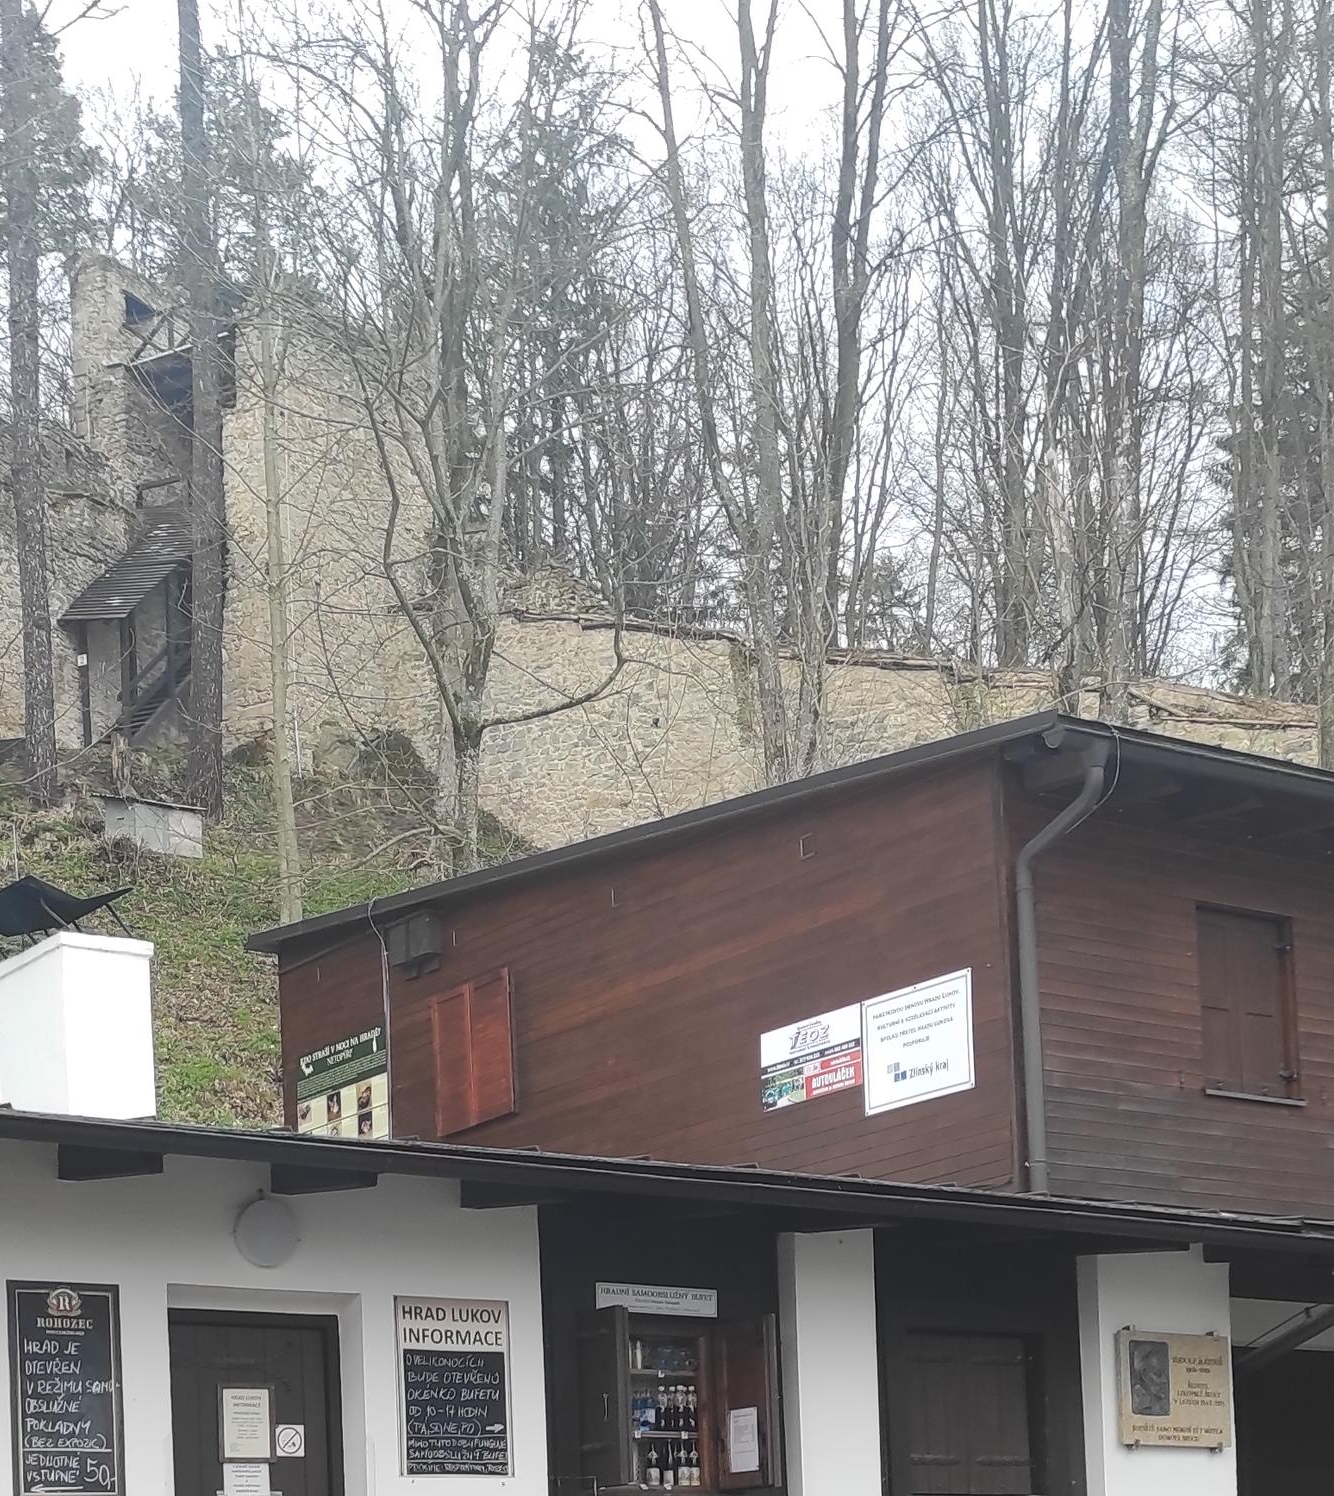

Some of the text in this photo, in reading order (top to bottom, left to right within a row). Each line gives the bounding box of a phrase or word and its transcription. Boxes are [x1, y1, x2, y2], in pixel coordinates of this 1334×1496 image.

[909, 1058, 949, 1079] Zlínský kraj
[600, 1287, 629, 1296] HRADNÍ
[402, 1305, 502, 1324] HRAD LUKOV
[36, 1317, 93, 1329] ROHOZEC
[403, 1327, 503, 1346] INFORMACE
[24, 1339, 80, 1354] HRAD JE
[26, 1357, 81, 1375] OTEVŘEN
[408, 1370, 499, 1384] BUDE OTEVŘENO
[27, 1382, 33, 1395] V
[38, 1377, 83, 1394] REŽIMU
[407, 1383, 499, 1401] OKÉNKO BUFETU
[409, 1406, 421, 1417] OD
[458, 1406, 488, 1417] HODIN
[25, 1417, 91, 1435] POKLADNY
[25, 1436, 56, 1449] (BEZ
[26, 1452, 80, 1468] JEDNOTNÉ
[27, 1469, 80, 1483] VSTUPNÉ
